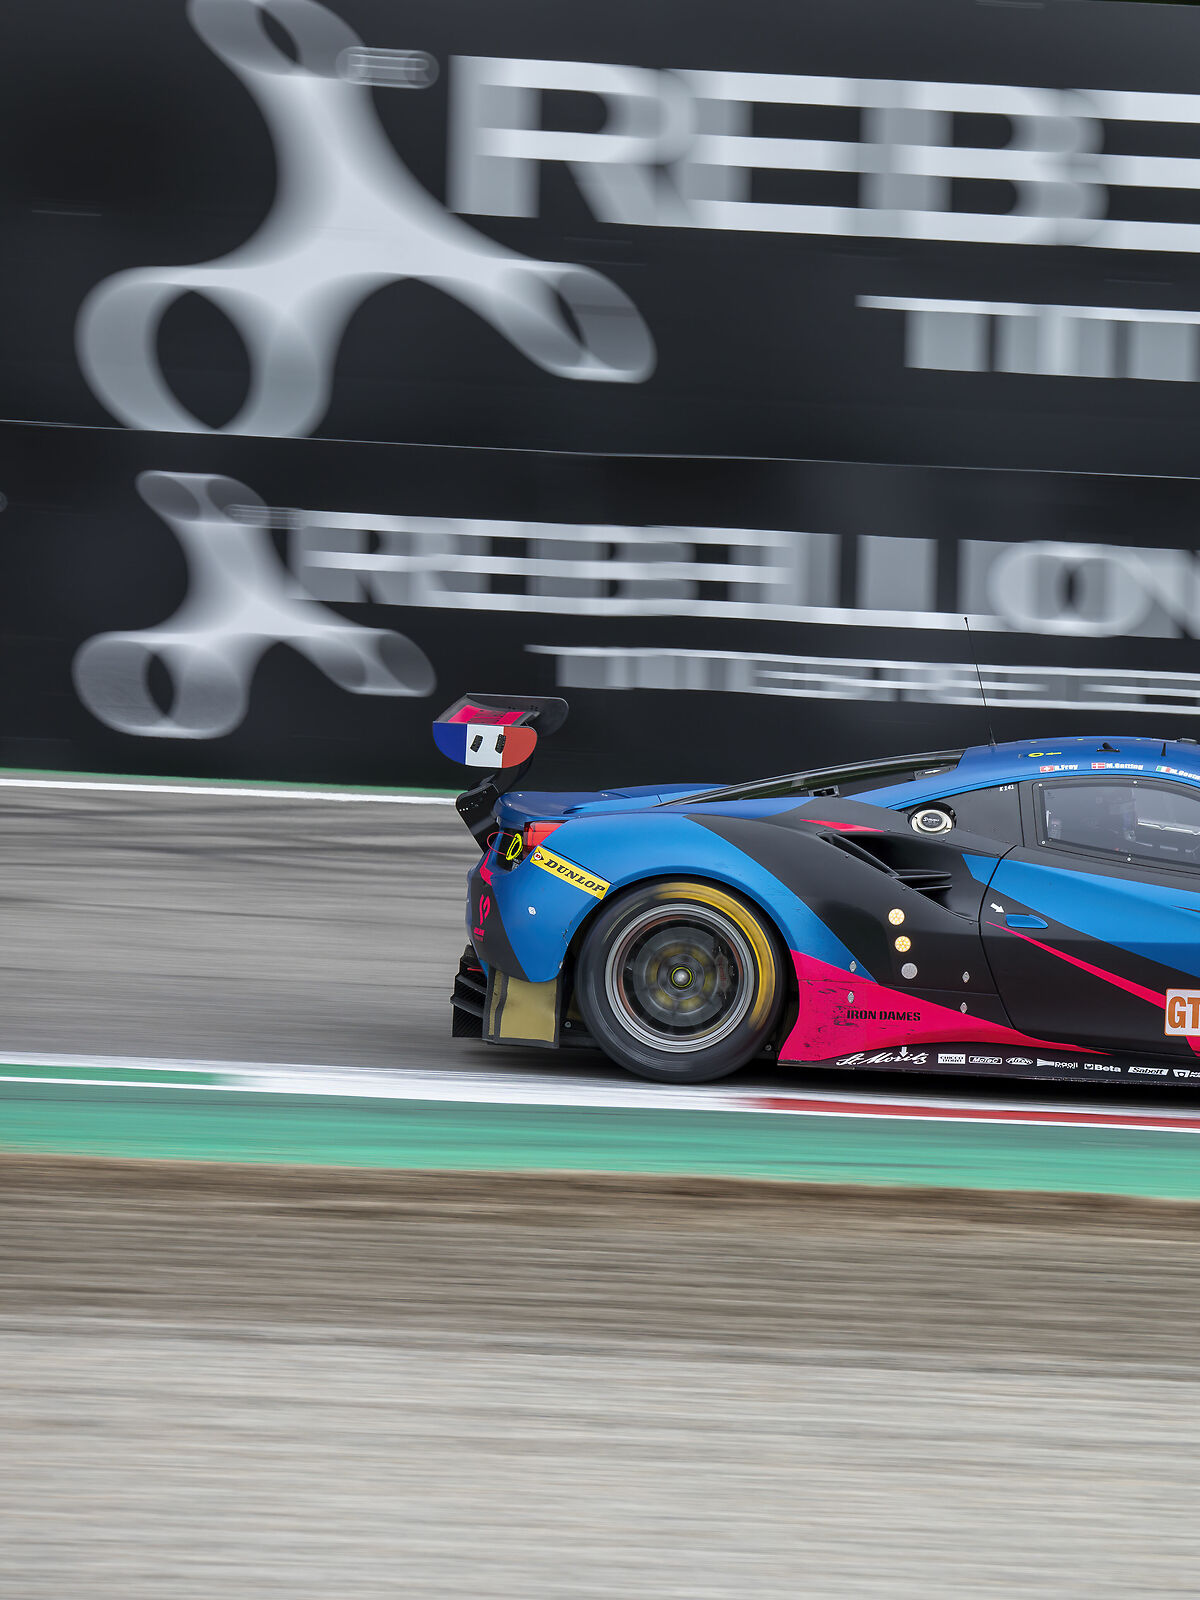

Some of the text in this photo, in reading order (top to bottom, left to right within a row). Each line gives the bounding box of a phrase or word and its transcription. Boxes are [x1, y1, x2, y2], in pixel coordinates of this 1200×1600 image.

[543, 858, 606, 894] DUNLOP
[846, 1009, 921, 1021] IRON DAMES
[1094, 1063, 1122, 1073] Beta
